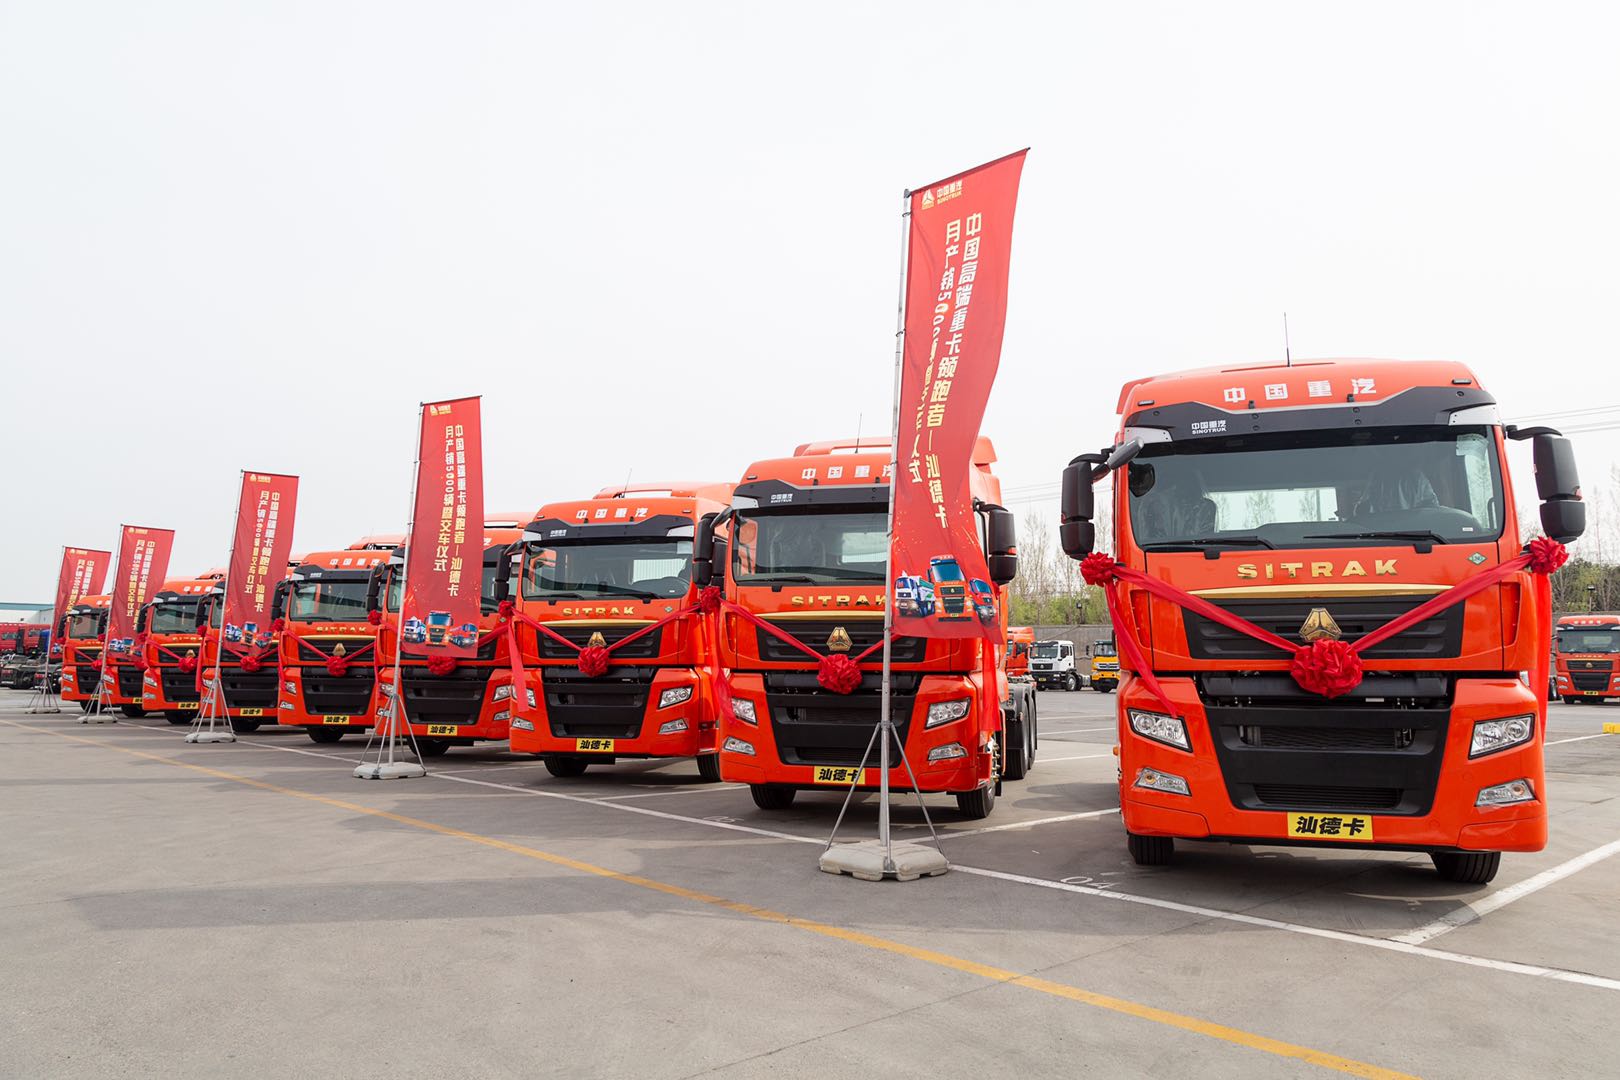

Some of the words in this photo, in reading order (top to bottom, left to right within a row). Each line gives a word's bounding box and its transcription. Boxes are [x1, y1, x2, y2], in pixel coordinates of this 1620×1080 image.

[1223, 378, 1377, 403] 中国重汽
[1191, 420, 1227, 430] 中国重汽
[1191, 427, 1227, 435] SINOTRUK
[1237, 559, 1399, 579] SITRAK
[791, 595, 887, 607] SITRAK
[562, 606, 635, 617] SITRAK
[579, 740, 611, 750] 汕德卡
[818, 768, 860, 782] 汕德卡
[1295, 815, 1365, 836] 汕德卡
